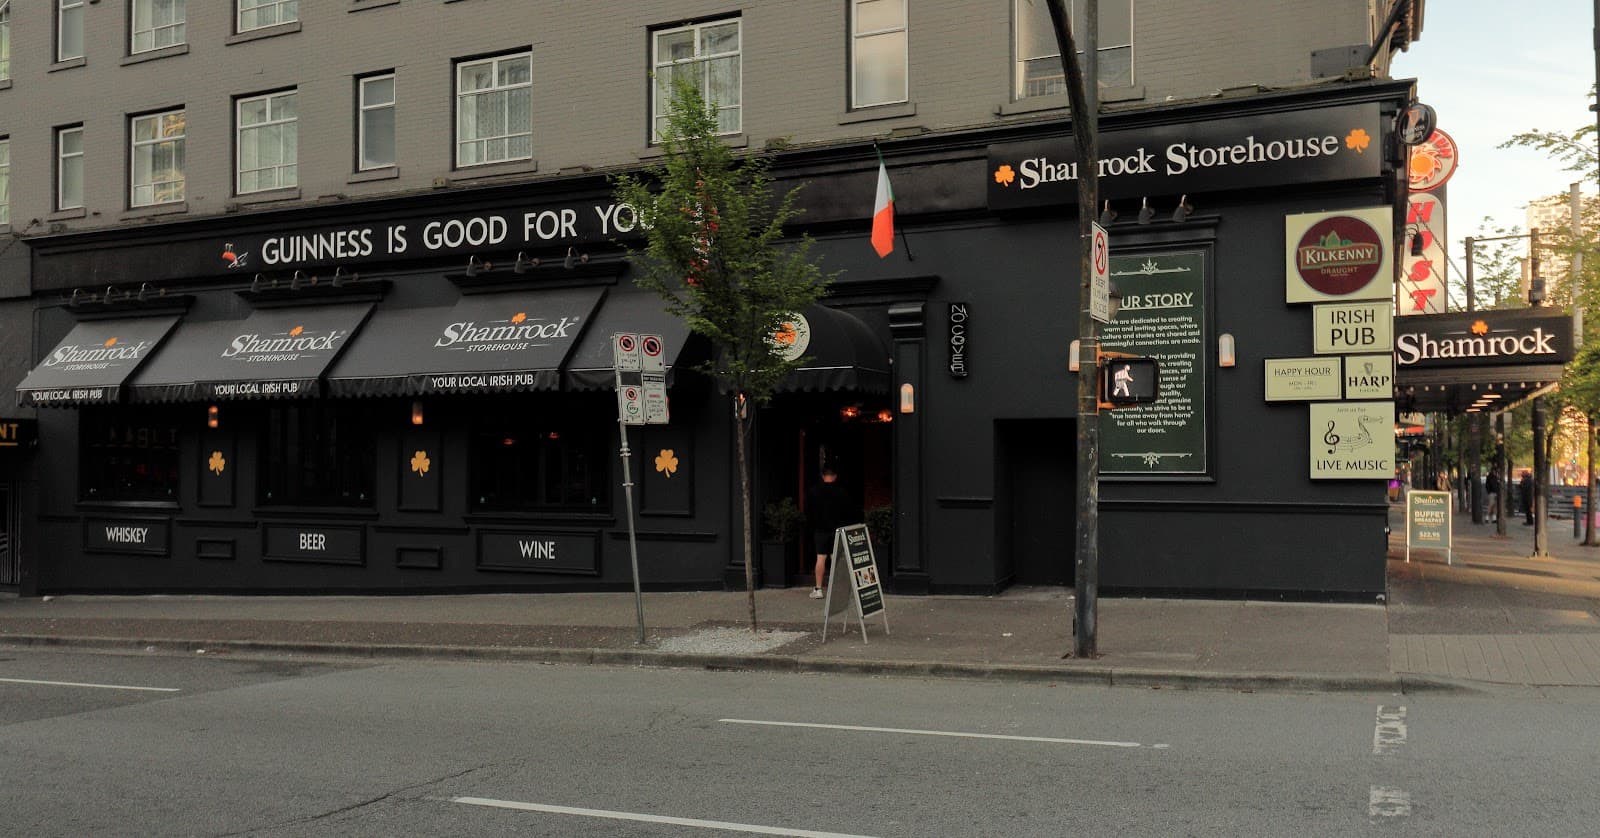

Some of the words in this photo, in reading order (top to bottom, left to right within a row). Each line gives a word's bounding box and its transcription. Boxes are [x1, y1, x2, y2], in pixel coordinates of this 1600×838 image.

[1019, 147, 1156, 190] Sharock
[1165, 134, 1340, 176] Storehouse
[262, 228, 373, 265] GUINNESS
[387, 225, 407, 254] IS
[423, 215, 507, 250] GOOD
[524, 208, 577, 241] FOR
[1305, 247, 1373, 265] KILKENNY
[1320, 266, 1359, 275] DRAUGHT
[1121, 295, 1141, 308] UR
[1144, 292, 1194, 308] STORY
[1331, 309, 1375, 325] IRISH
[434, 318, 570, 348] Shamrock
[1331, 327, 1376, 346] PUB
[221, 330, 341, 358] Shamrock
[466, 342, 528, 353] STOREHOUSE
[1397, 327, 1557, 366] Shamrock
[43, 341, 148, 367] Shamrock
[246, 353, 301, 363] STOREHOUSE
[63, 361, 109, 371] STOREHOUSE
[1274, 367, 1303, 377] HAPPY
[1304, 366, 1332, 376] HOUR
[214, 384, 236, 395] YOUR
[237, 384, 261, 395] LOCAL
[262, 383, 282, 394] IRISH
[283, 383, 299, 394] PUB
[431, 376, 456, 388] YOUR
[458, 376, 487, 388] LOCAL
[489, 375, 513, 387] IRISH
[514, 375, 534, 386] PUB
[1348, 375, 1390, 389] HARP
[31, 391, 51, 401] YOUR
[50, 391, 71, 401] LOCAL
[72, 390, 89, 400] IRISH
[89, 390, 103, 400] PUB
[1316, 459, 1342, 471] LIVE
[1345, 459, 1389, 471] MUSIC
[105, 526, 148, 544] WHISKEY
[299, 533, 326, 550] BEER
[519, 541, 556, 559] WINE
